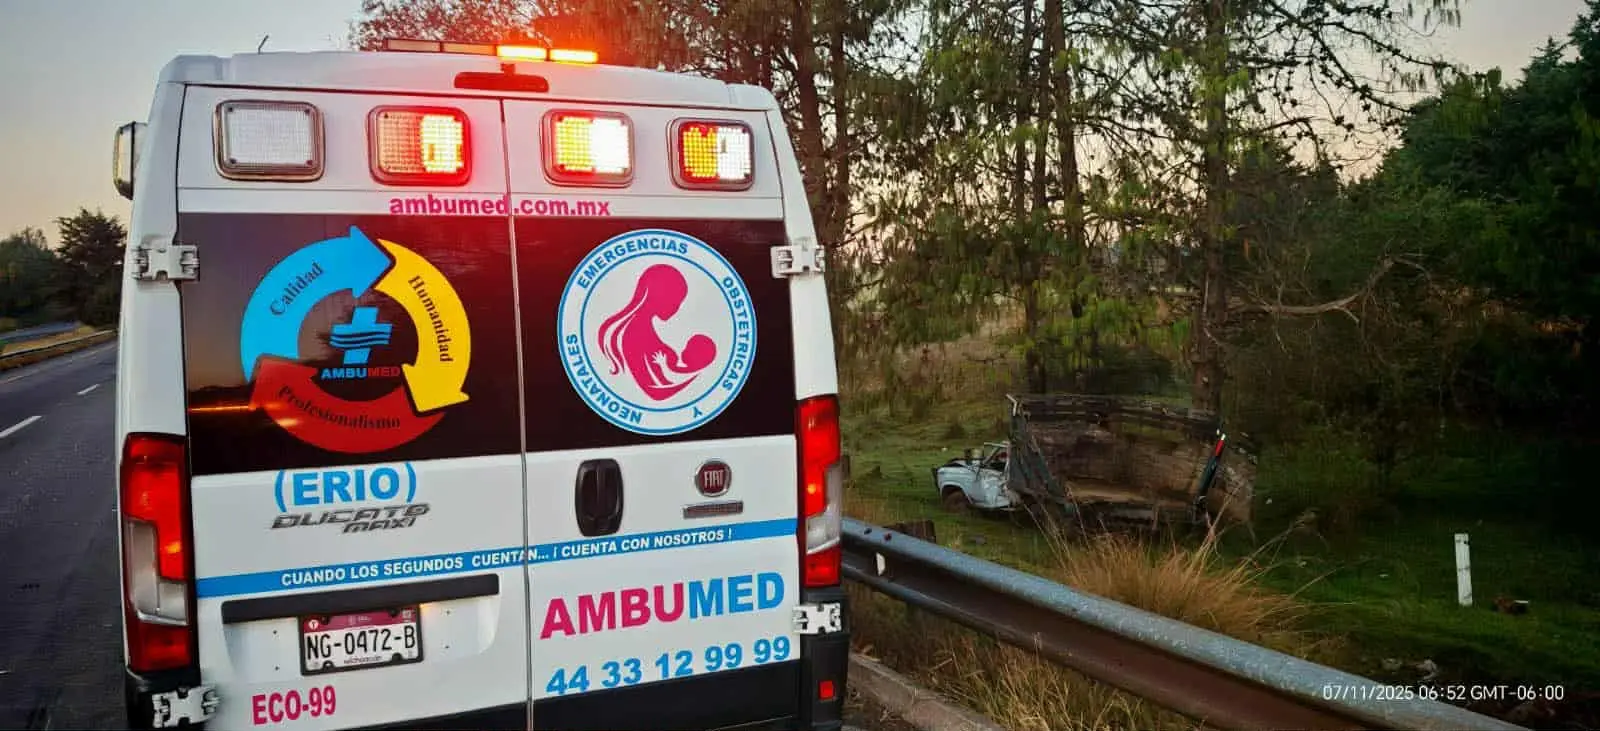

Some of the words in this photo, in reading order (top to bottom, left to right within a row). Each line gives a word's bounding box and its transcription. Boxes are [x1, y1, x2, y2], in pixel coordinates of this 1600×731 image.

[389, 194, 611, 215] ambumed.com.mx
[269, 261, 324, 317] Calidad
[577, 238, 689, 289] EMERGENCIAS
[408, 275, 454, 362] Humanidad
[721, 275, 750, 392] OBSTETRICAS
[321, 367, 401, 380] AMBUMED
[566, 333, 643, 424] NEONATALES
[278, 384, 401, 430] Profesionalismo
[692, 406, 703, 418] Y
[274, 461, 417, 513] (ERIO)
[704, 469, 724, 489] FIAT
[271, 503, 430, 530] DUCATO
[281, 567, 346, 586] CUANDO
[350, 564, 379, 580] LOS
[383, 556, 463, 576] SEGUNDOS
[561, 541, 617, 558] CUENTA
[621, 536, 650, 551] CON
[654, 529, 724, 548] NOSOTROS
[539, 571, 785, 640] AMBUMED
[306, 625, 416, 661] NG-0472-B
[545, 664, 590, 695] 44
[601, 657, 642, 688] 33
[655, 650, 693, 679] 12
[704, 642, 743, 672] 99
[753, 635, 791, 663] 99
[252, 685, 336, 725] ECO-99
